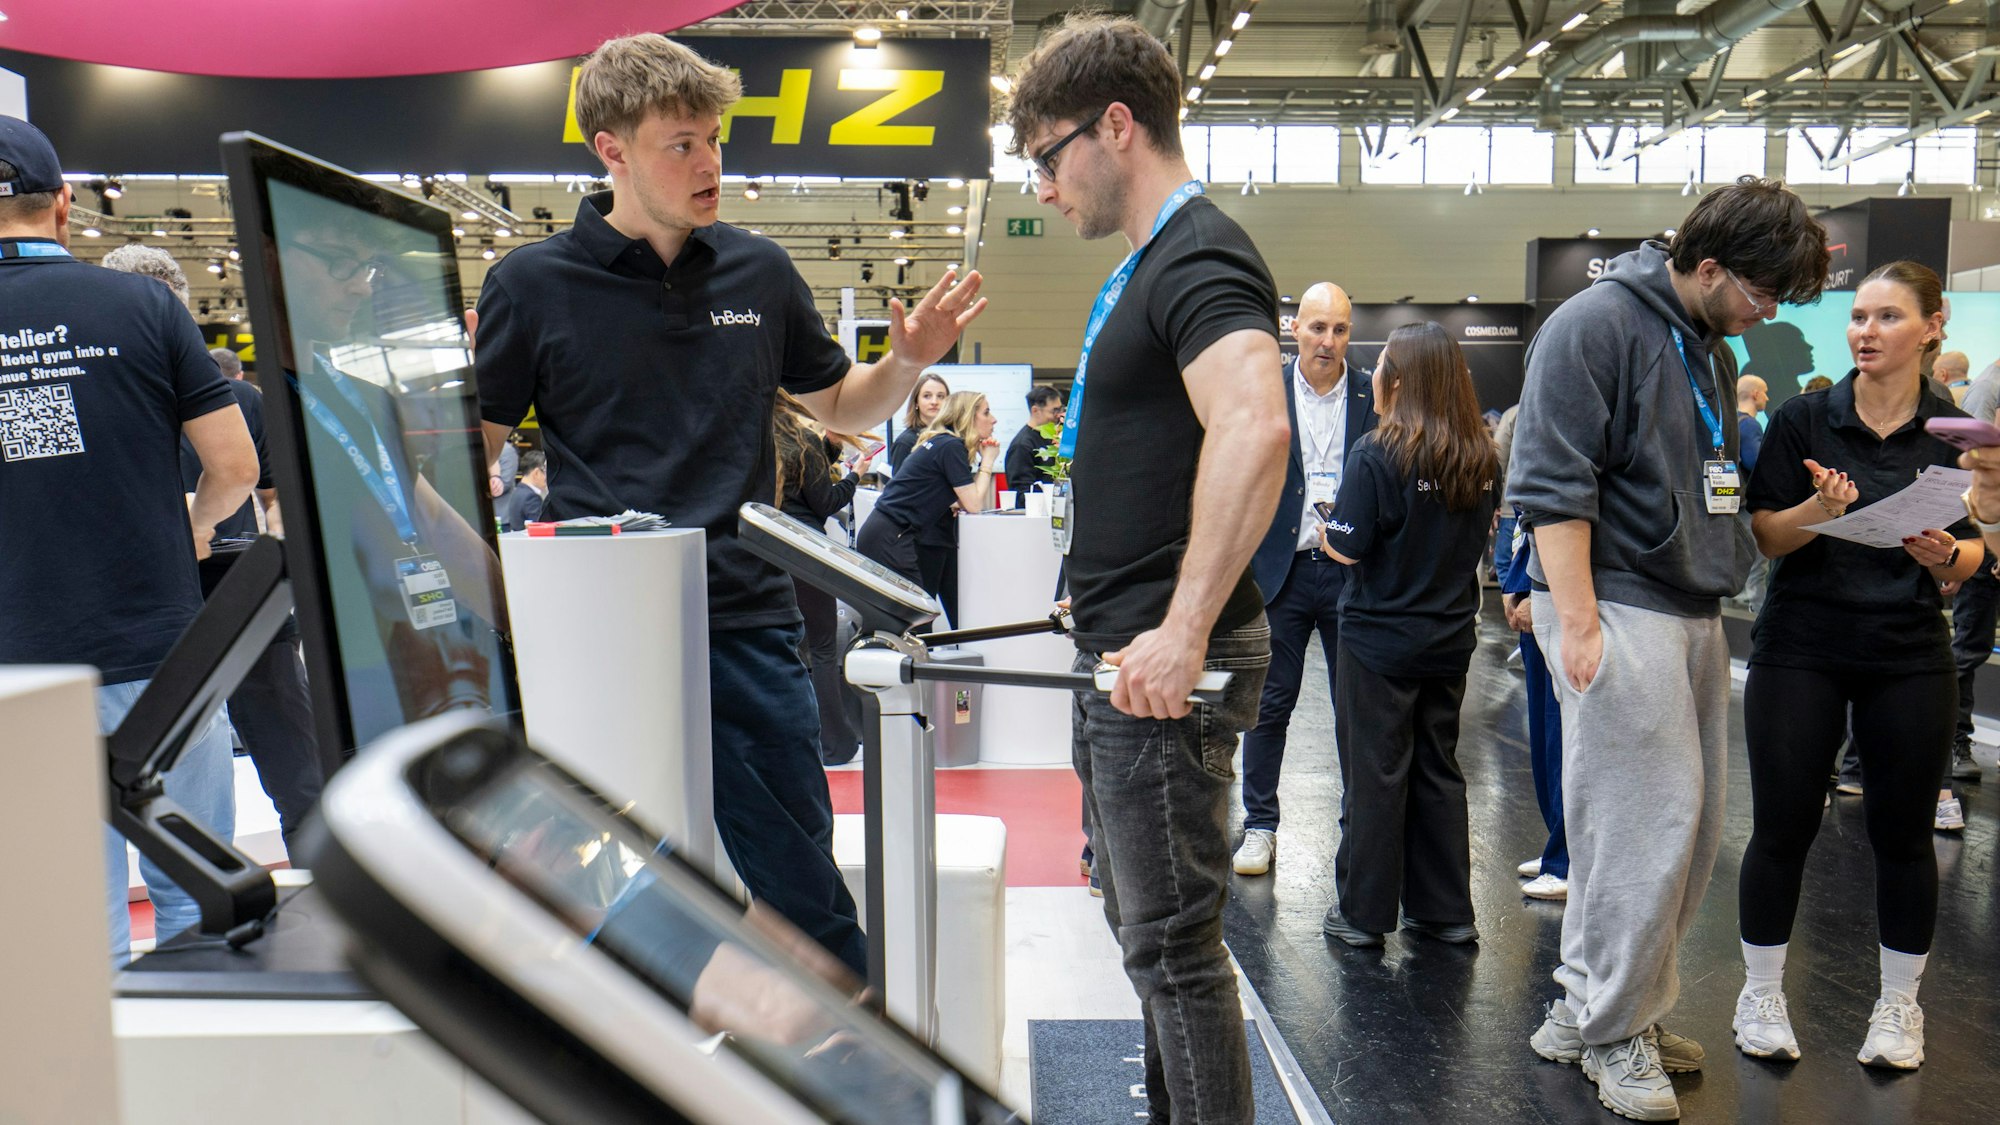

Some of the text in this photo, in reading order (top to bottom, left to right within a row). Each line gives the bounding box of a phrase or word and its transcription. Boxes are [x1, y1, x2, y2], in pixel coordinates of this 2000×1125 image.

[562, 68, 945, 146] HZ
[710, 308, 761, 327] InBody
[0, 324, 68, 349] telier?
[1464, 326, 1518, 337] COSMED.COM
[1, 345, 119, 367] Hotel gym into a
[30, 365, 86, 380] Stream.
